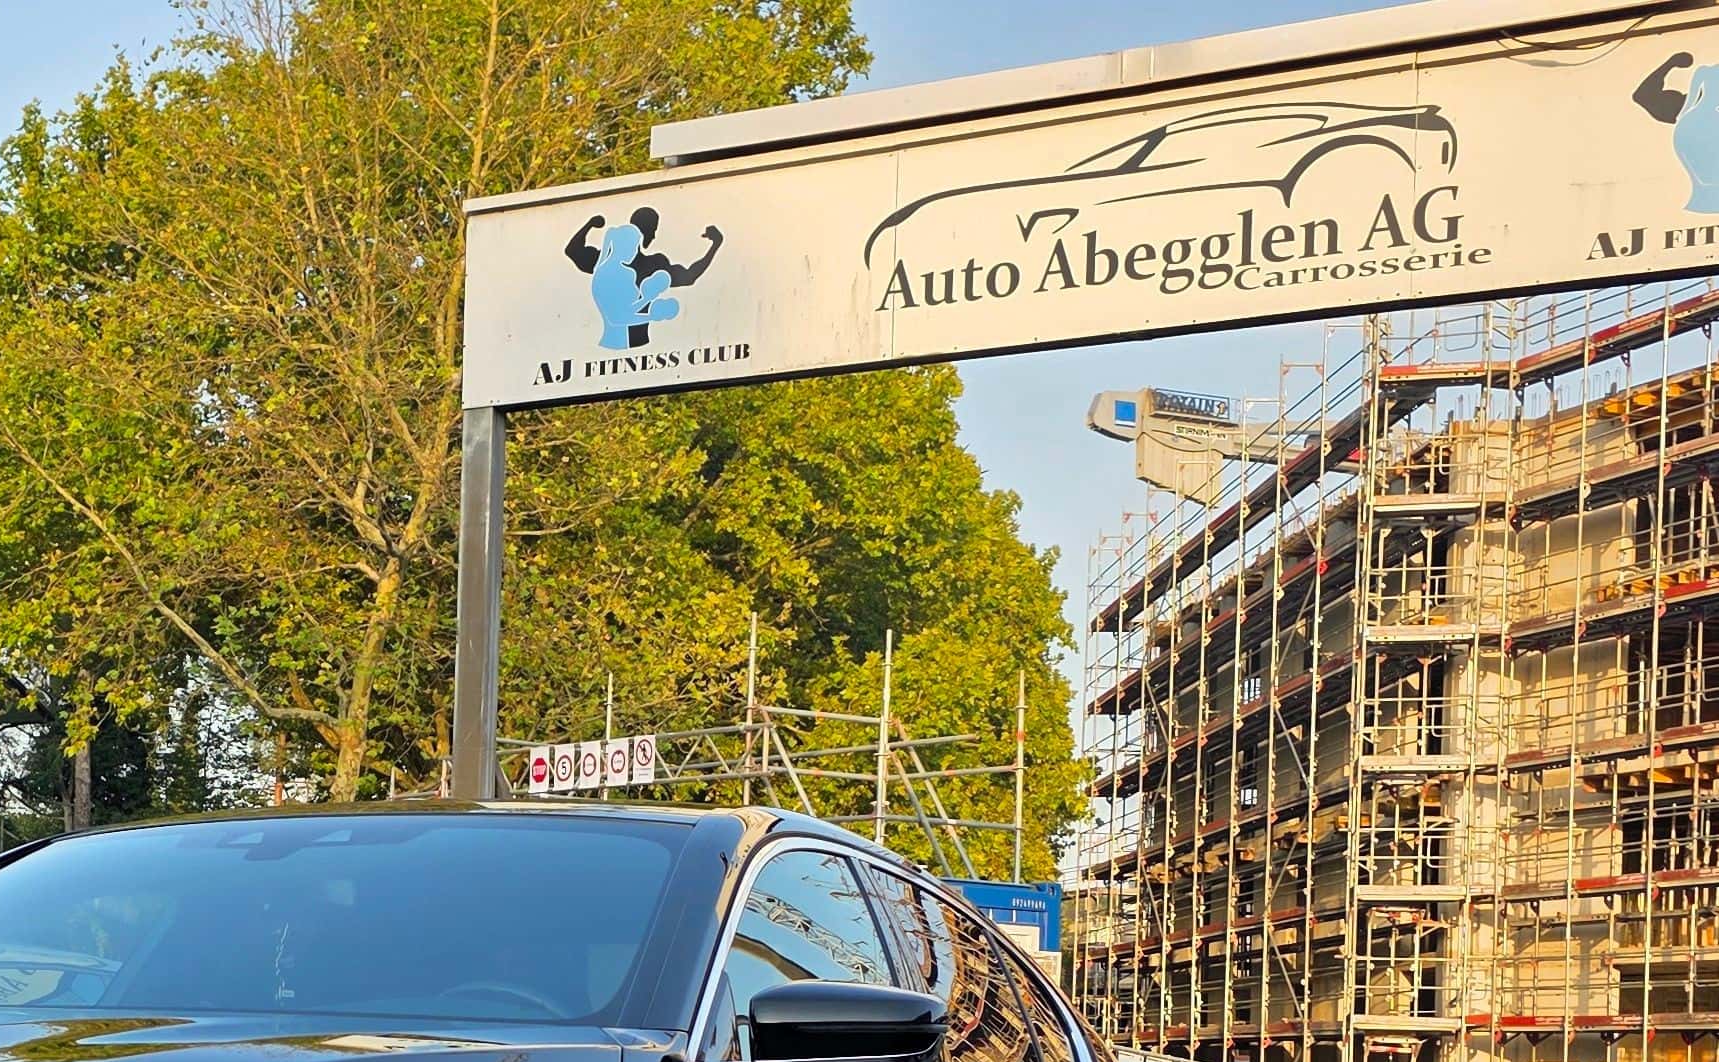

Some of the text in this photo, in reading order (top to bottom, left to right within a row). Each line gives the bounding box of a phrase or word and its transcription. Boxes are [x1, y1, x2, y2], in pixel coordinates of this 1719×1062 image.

[875, 185, 1464, 312] Auto Abegglen AG
[1586, 225, 1719, 260] AJ FIT
[1233, 243, 1492, 291] Carrosserie
[533, 343, 751, 386] AJ FITNESS CLUB
[560, 761, 567, 776] 5
